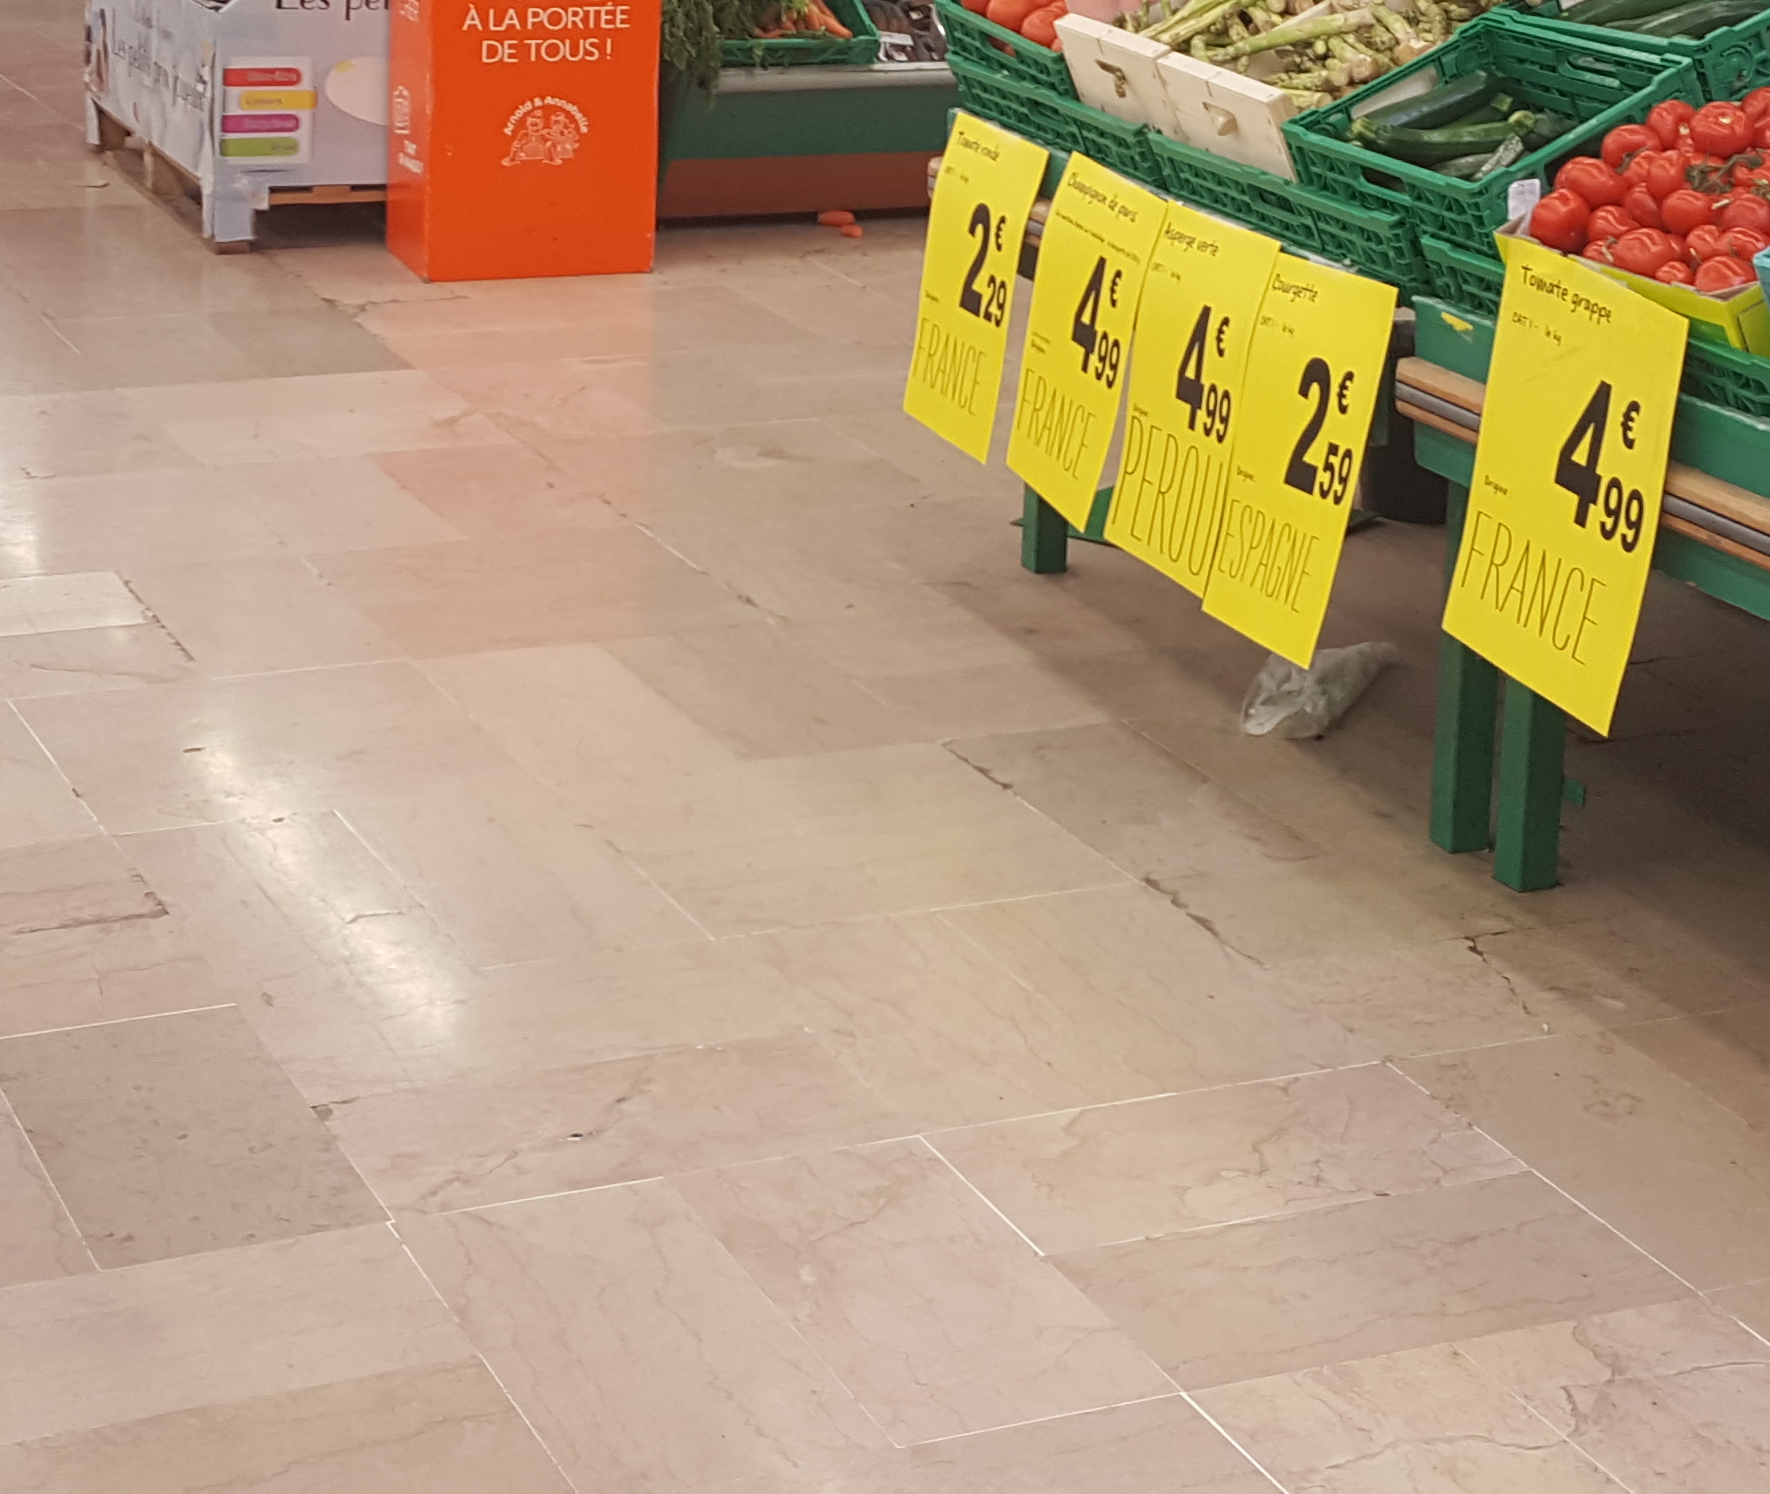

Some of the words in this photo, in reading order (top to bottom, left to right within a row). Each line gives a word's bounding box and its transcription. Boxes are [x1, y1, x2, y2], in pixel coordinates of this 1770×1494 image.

[462, 3, 483, 31] À
[489, 7, 521, 31] LA
[526, 2, 631, 31] PORTÉE
[481, 40, 519, 63] DE
[524, 39, 601, 62] TOUS
[504, 100, 533, 136] Arnold
[544, 95, 589, 134] Annabelle
[1272, 273, 1318, 303] Courgette
[1521, 263, 1568, 302] Tomate
[1570, 292, 1612, 325] grappe
[913, 317, 988, 417] FRANCE
[1015, 367, 1097, 481] FRANCE
[1112, 413, 1226, 578] PEROU
[1217, 499, 1320, 613] ESPAGNE
[1461, 509, 1606, 667] FRANCE
